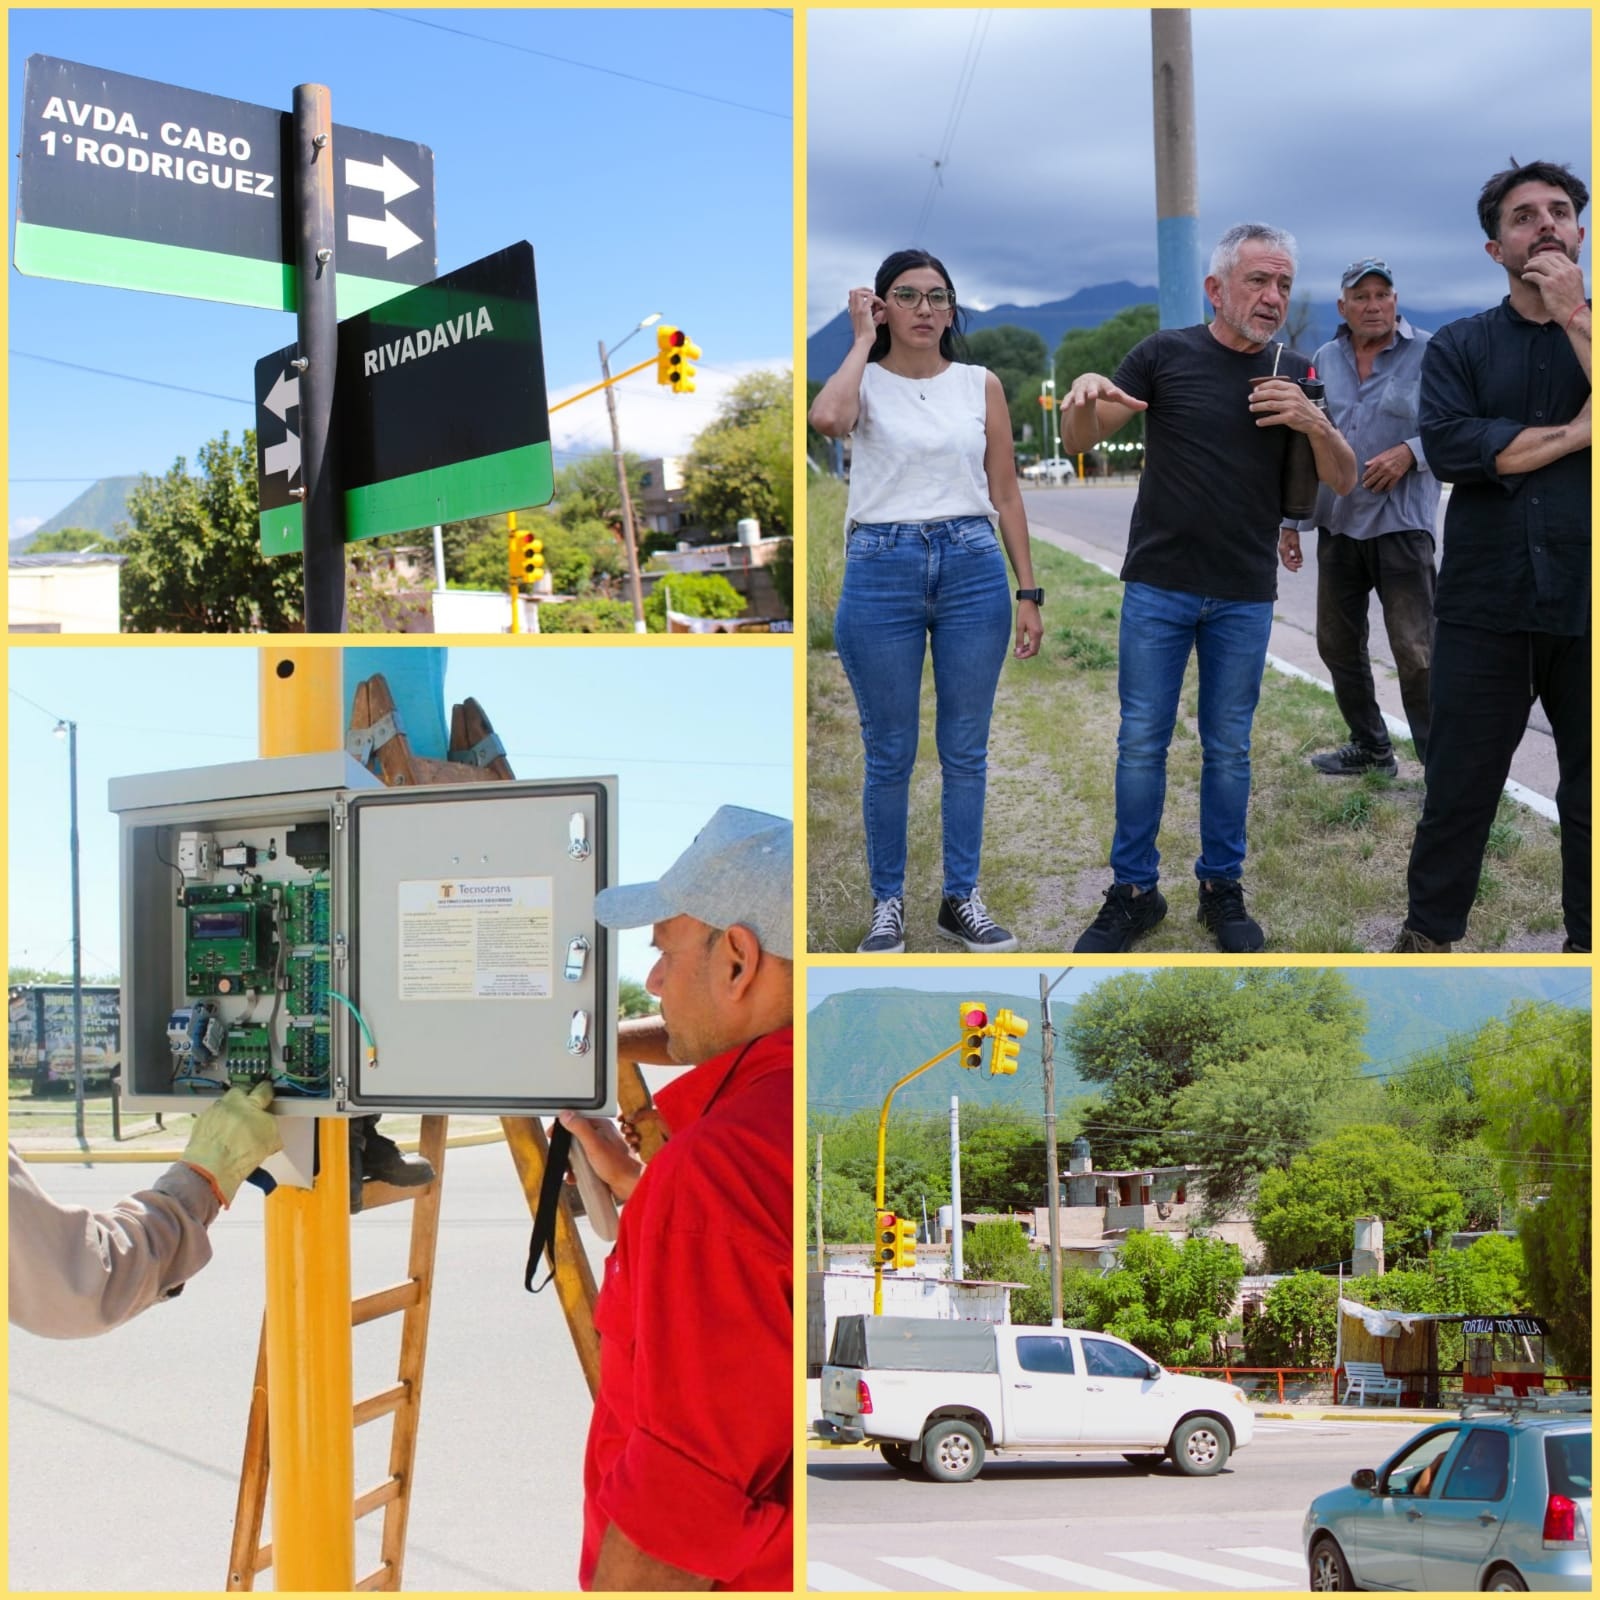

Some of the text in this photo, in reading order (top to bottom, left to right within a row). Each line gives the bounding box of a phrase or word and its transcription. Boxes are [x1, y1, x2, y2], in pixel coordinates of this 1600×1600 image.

[41, 96, 251, 161] AVDA. CABO
[363, 305, 494, 377] RIVADAVIA
[458, 883, 511, 895] Tecnotrans
[1462, 1319, 1494, 1333] TORTILLA
